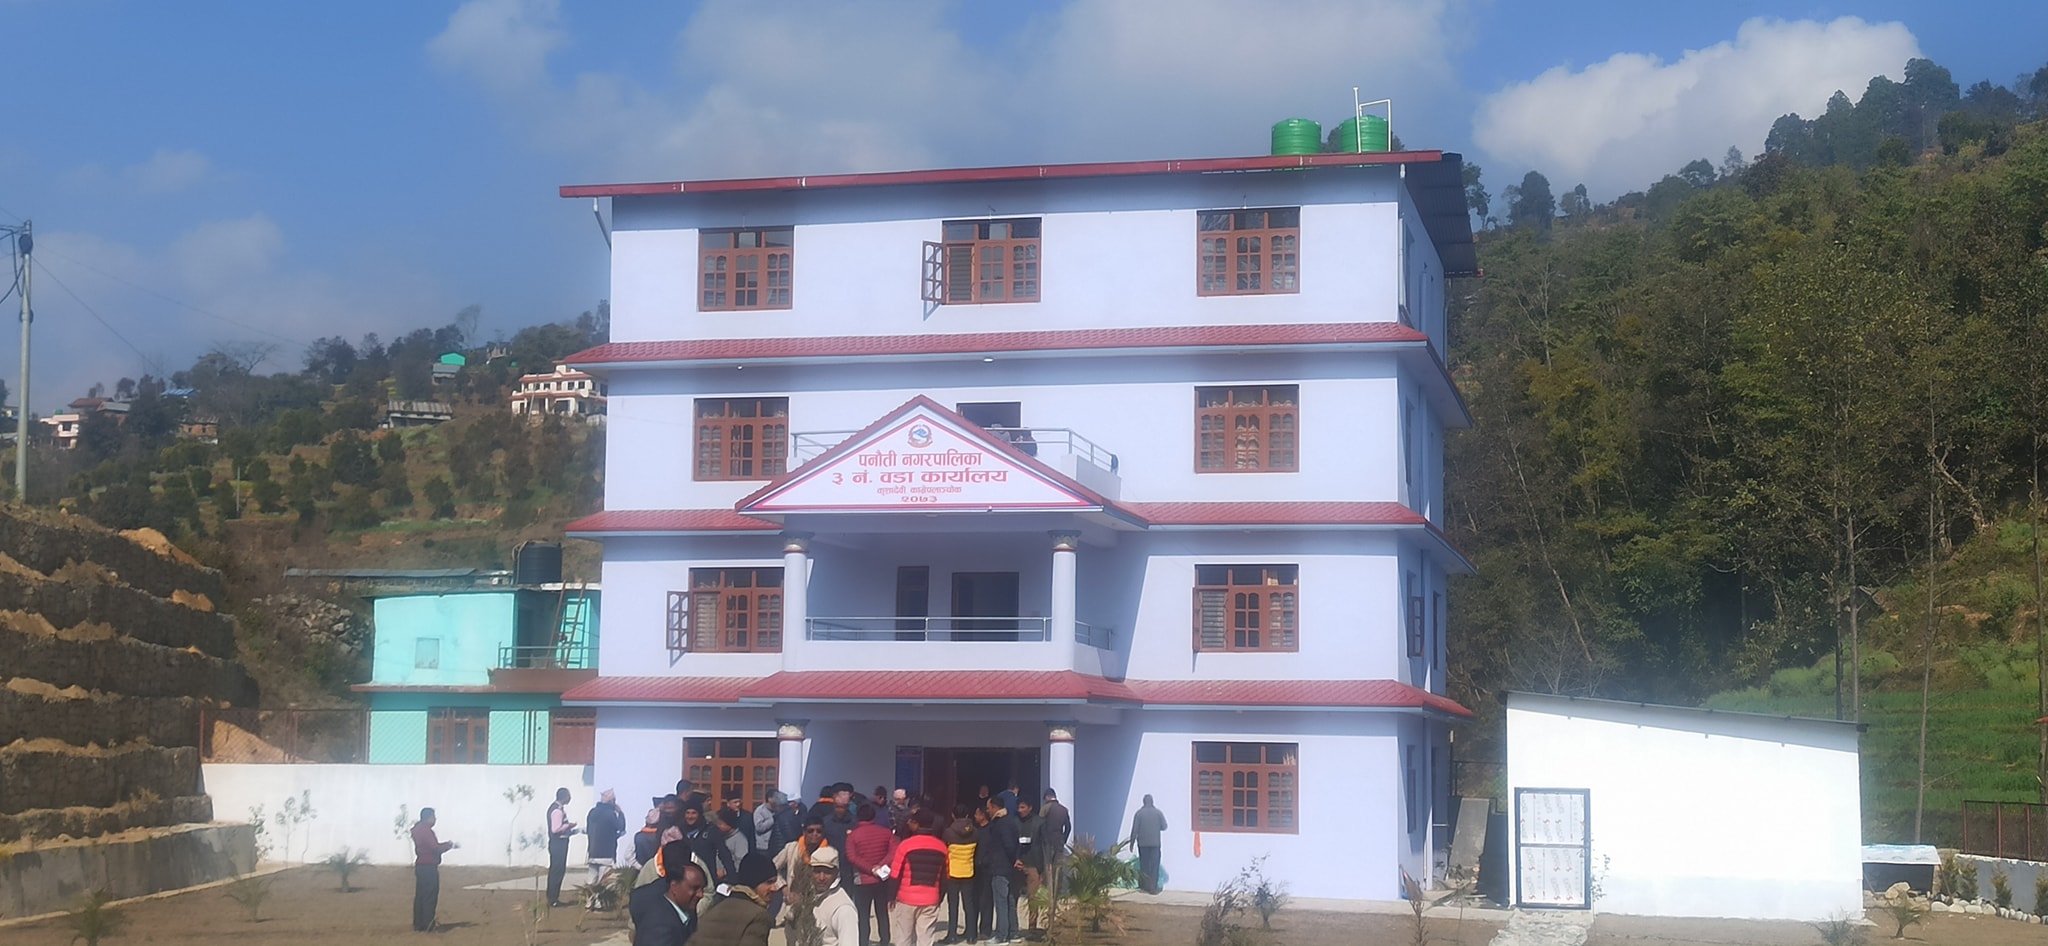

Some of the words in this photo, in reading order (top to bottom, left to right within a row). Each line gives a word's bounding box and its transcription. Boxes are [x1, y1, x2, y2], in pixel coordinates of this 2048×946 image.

[858, 450, 897, 467] पनौती
[902, 449, 982, 467] नगरपालिका
[832, 473, 843, 485] ३
[852, 469, 873, 484] नं.
[880, 471, 914, 484] वडा
[921, 467, 1008, 484] कार्यालय
